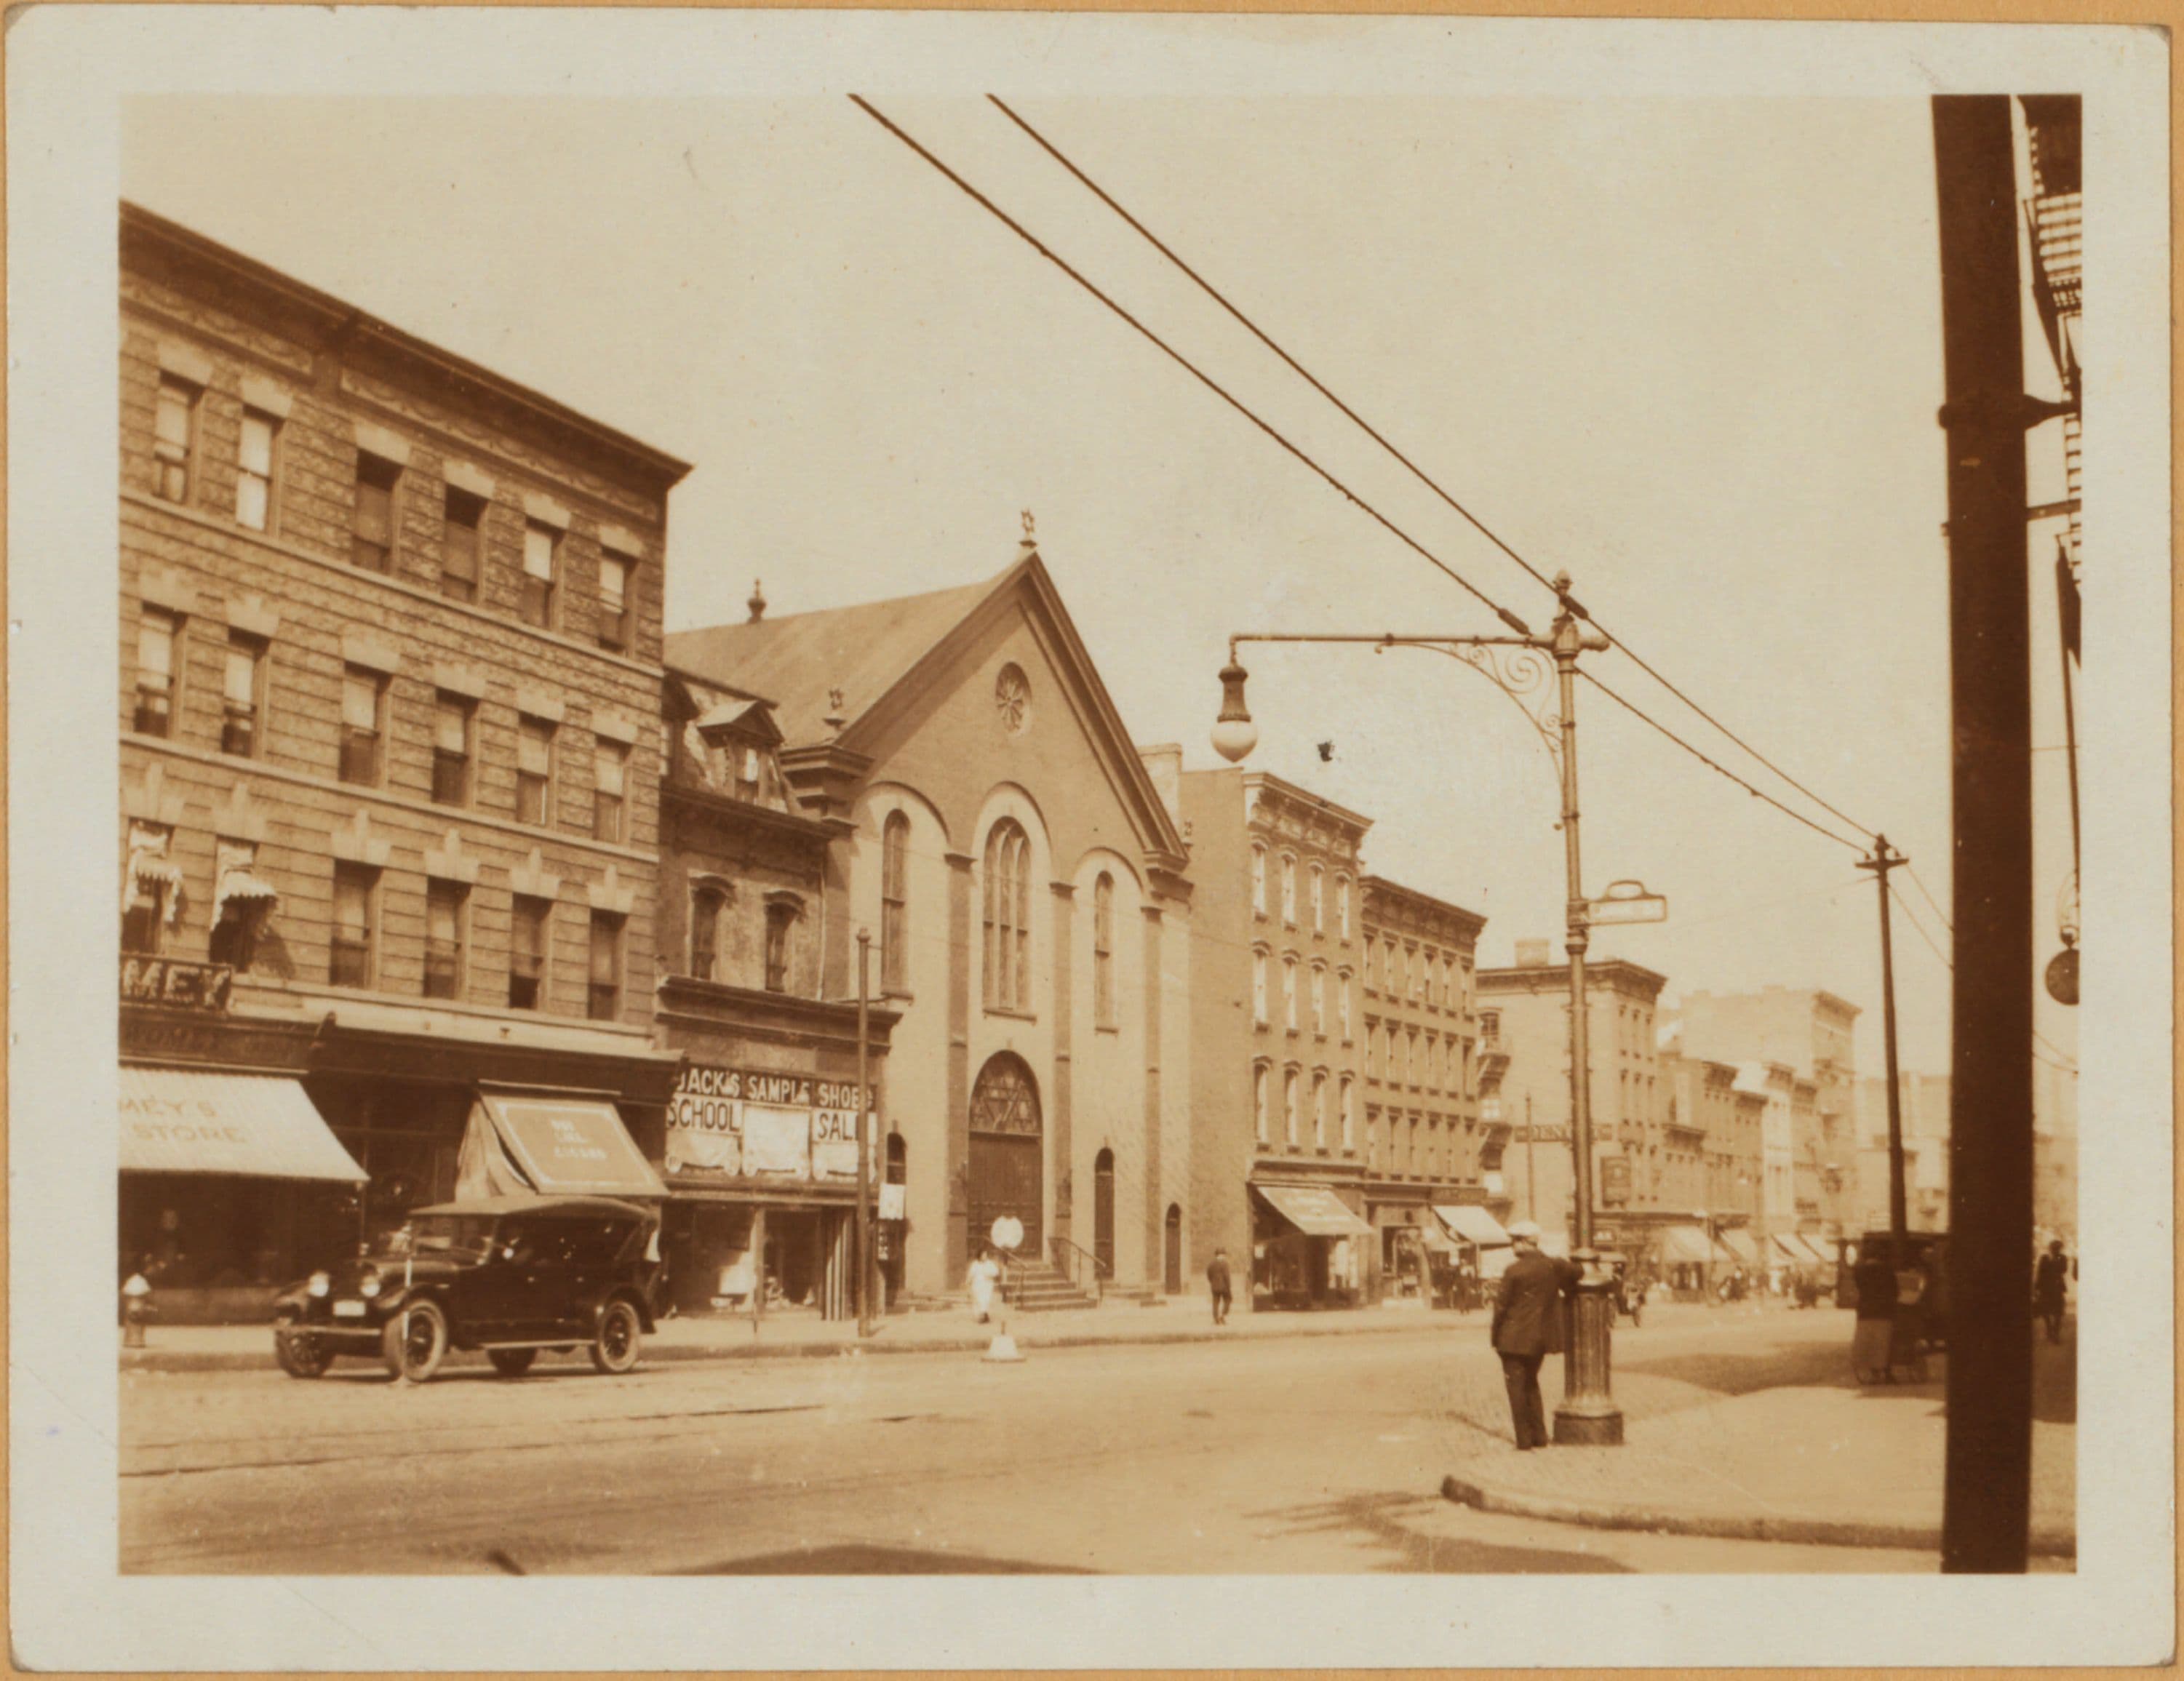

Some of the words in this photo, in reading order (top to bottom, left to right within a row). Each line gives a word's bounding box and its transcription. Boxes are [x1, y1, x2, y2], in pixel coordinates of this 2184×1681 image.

[122, 959, 230, 1007] MEY
[667, 1098, 741, 1133] SCHOOL
[818, 1112, 859, 1142] SAL
